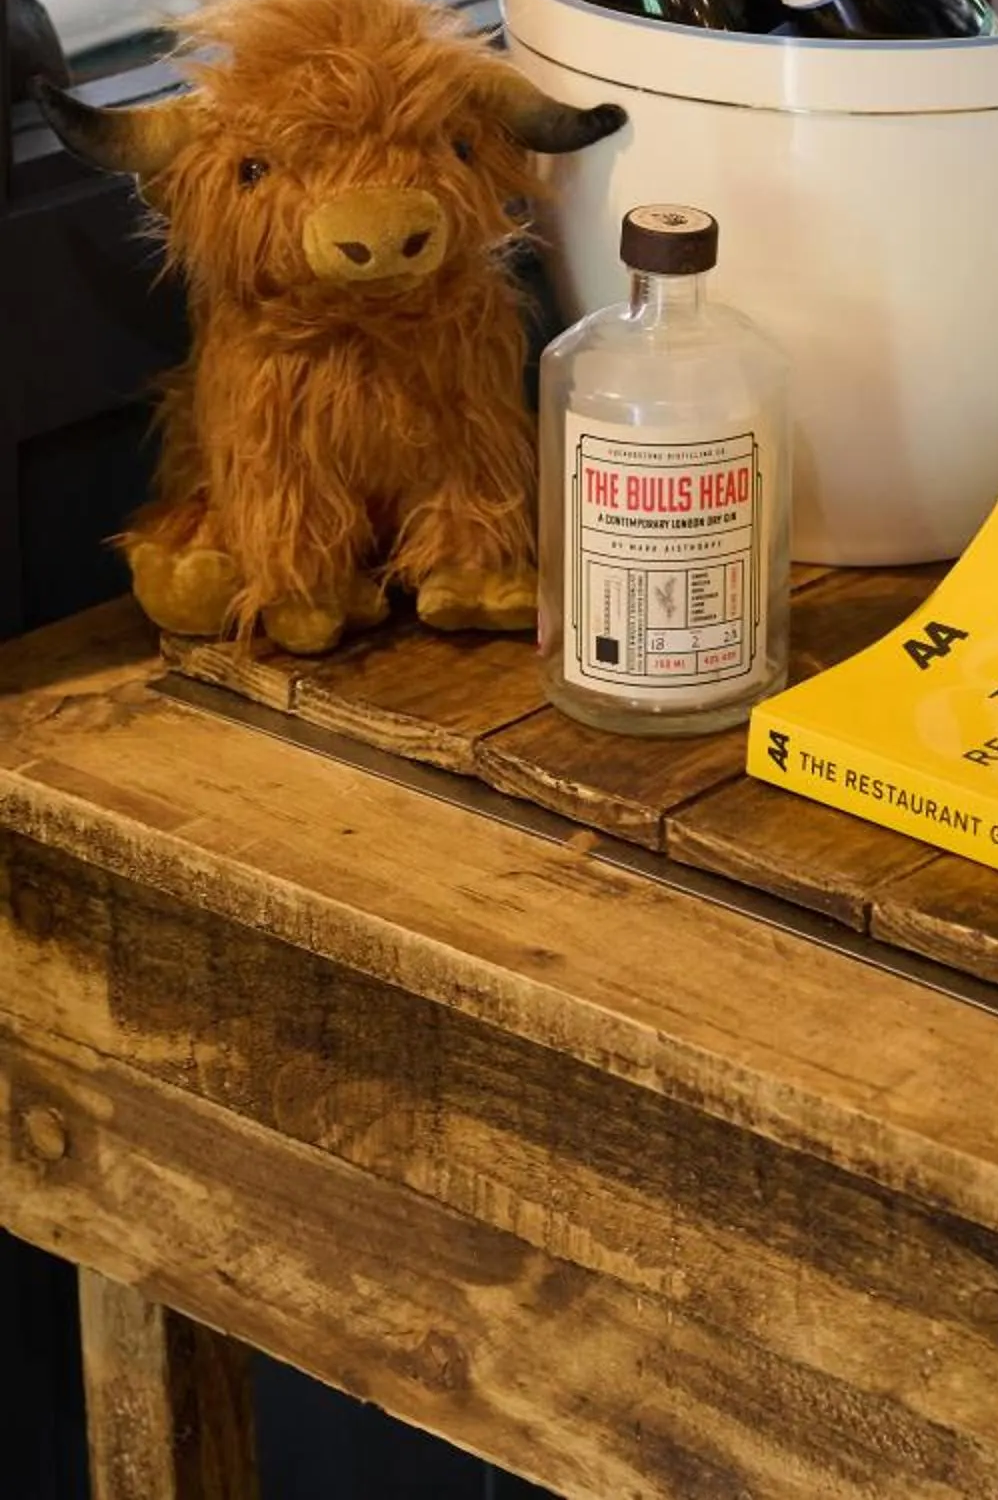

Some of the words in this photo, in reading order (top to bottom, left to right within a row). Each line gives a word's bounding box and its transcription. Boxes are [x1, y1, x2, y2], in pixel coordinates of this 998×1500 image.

[585, 467, 619, 510] THE
[627, 475, 693, 513] BULLS
[700, 467, 749, 511] HEAD
[605, 514, 671, 529] CONTEMPORARY
[671, 517, 704, 529] LONDON
[707, 515, 722, 526] DRY
[723, 511, 737, 523] GIN
[902, 621, 970, 670] AA
[767, 729, 790, 772] AA
[800, 751, 837, 782] THE
[845, 769, 983, 836] RESTAURANT
